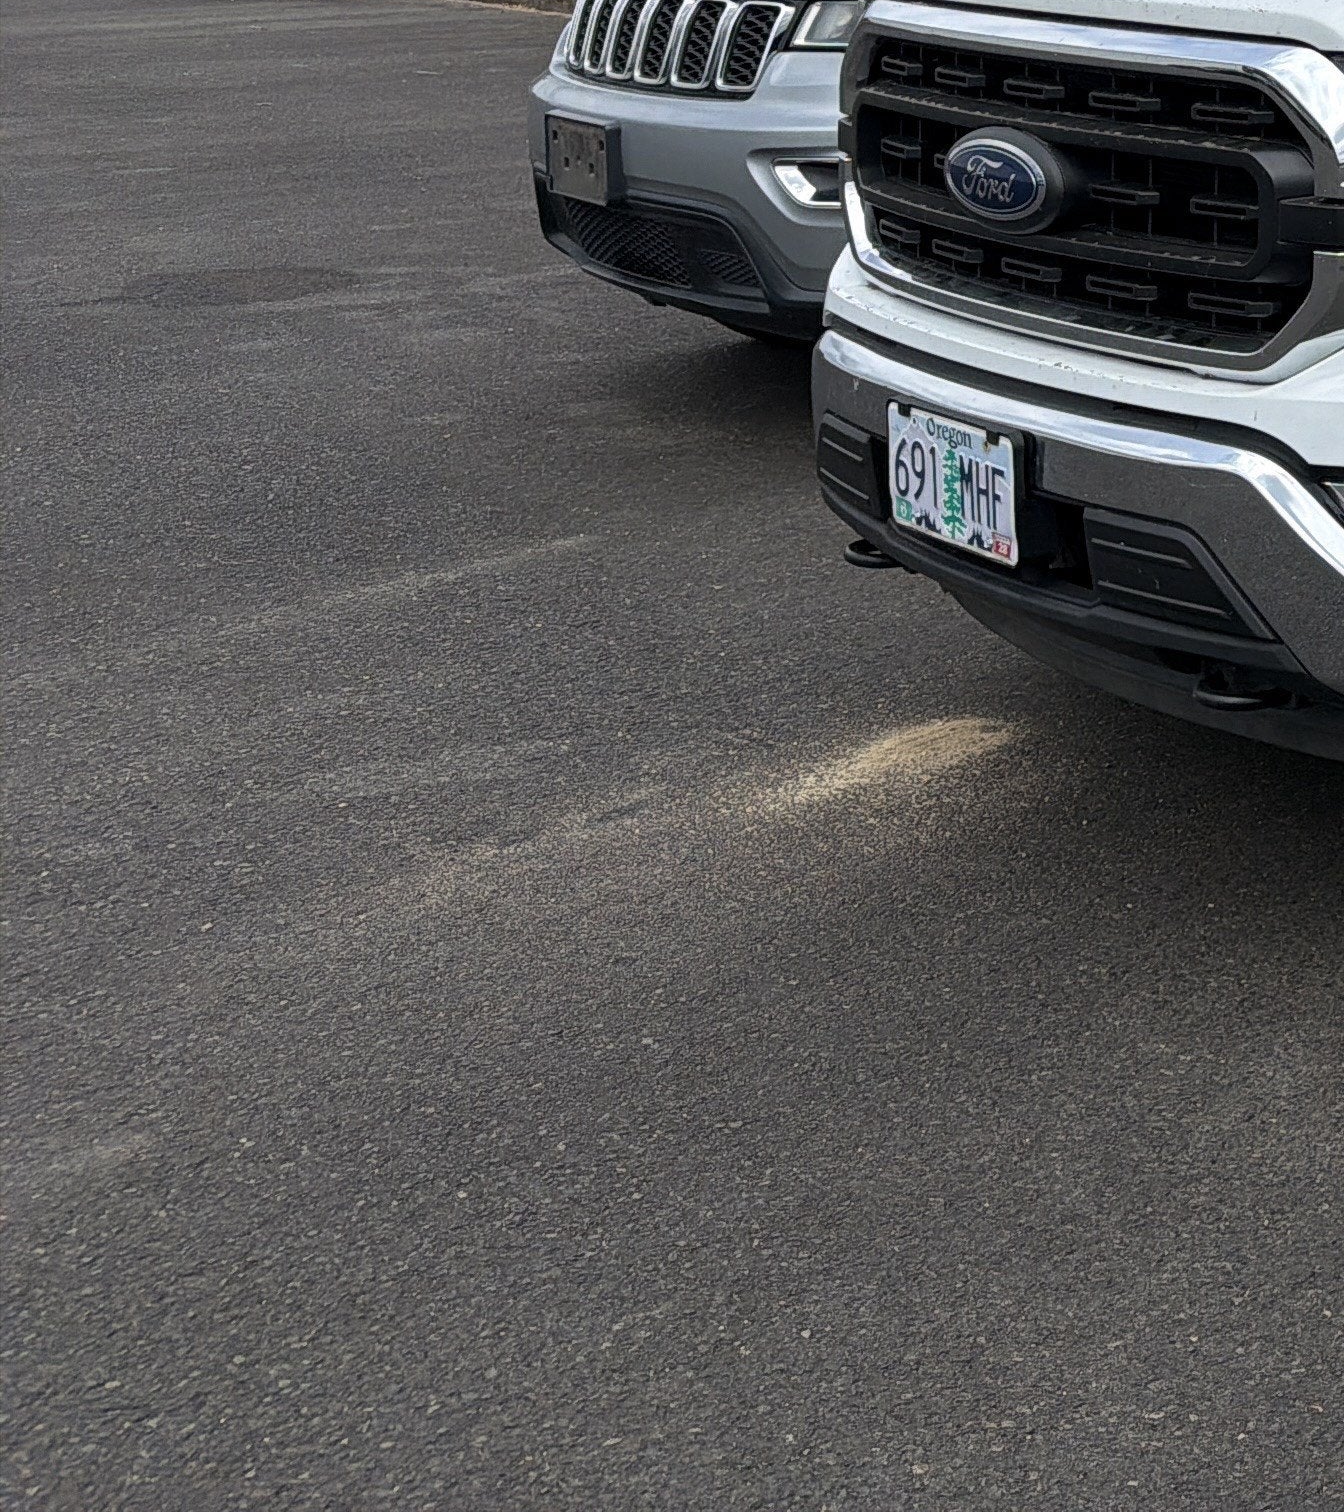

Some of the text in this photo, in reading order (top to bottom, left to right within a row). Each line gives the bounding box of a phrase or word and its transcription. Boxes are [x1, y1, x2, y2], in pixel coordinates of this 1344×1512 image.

[962, 155, 1016, 202] Ford
[926, 418, 973, 449] Oregon
[895, 438, 1006, 531] 691 MHF
